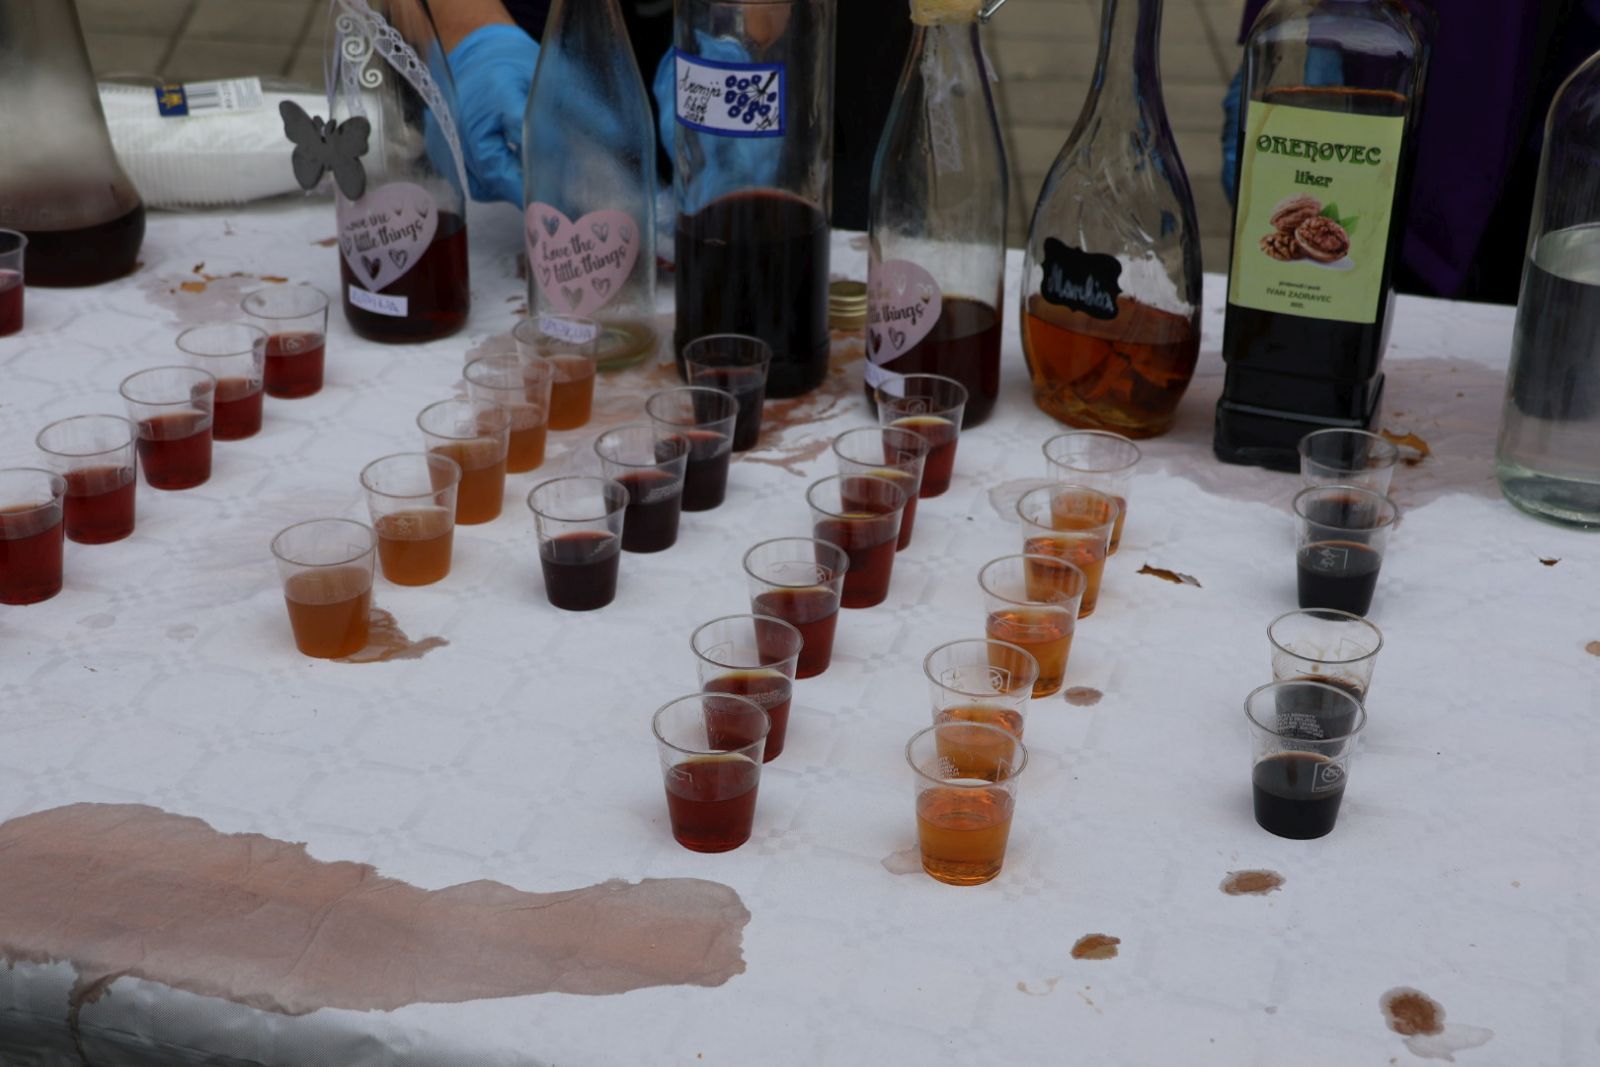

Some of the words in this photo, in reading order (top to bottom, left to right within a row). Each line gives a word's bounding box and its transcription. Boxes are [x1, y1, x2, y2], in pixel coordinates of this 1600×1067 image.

[1256, 134, 1382, 166] OREHOVEC
[1295, 169, 1333, 188] liker
[353, 230, 379, 253] little
[378, 218, 424, 246] things
[542, 240, 572, 262] Love
[570, 233, 596, 255] the
[553, 260, 582, 284] little
[582, 245, 627, 272] things
[1266, 287, 1286, 297] IVAN
[882, 303, 925, 326] things
